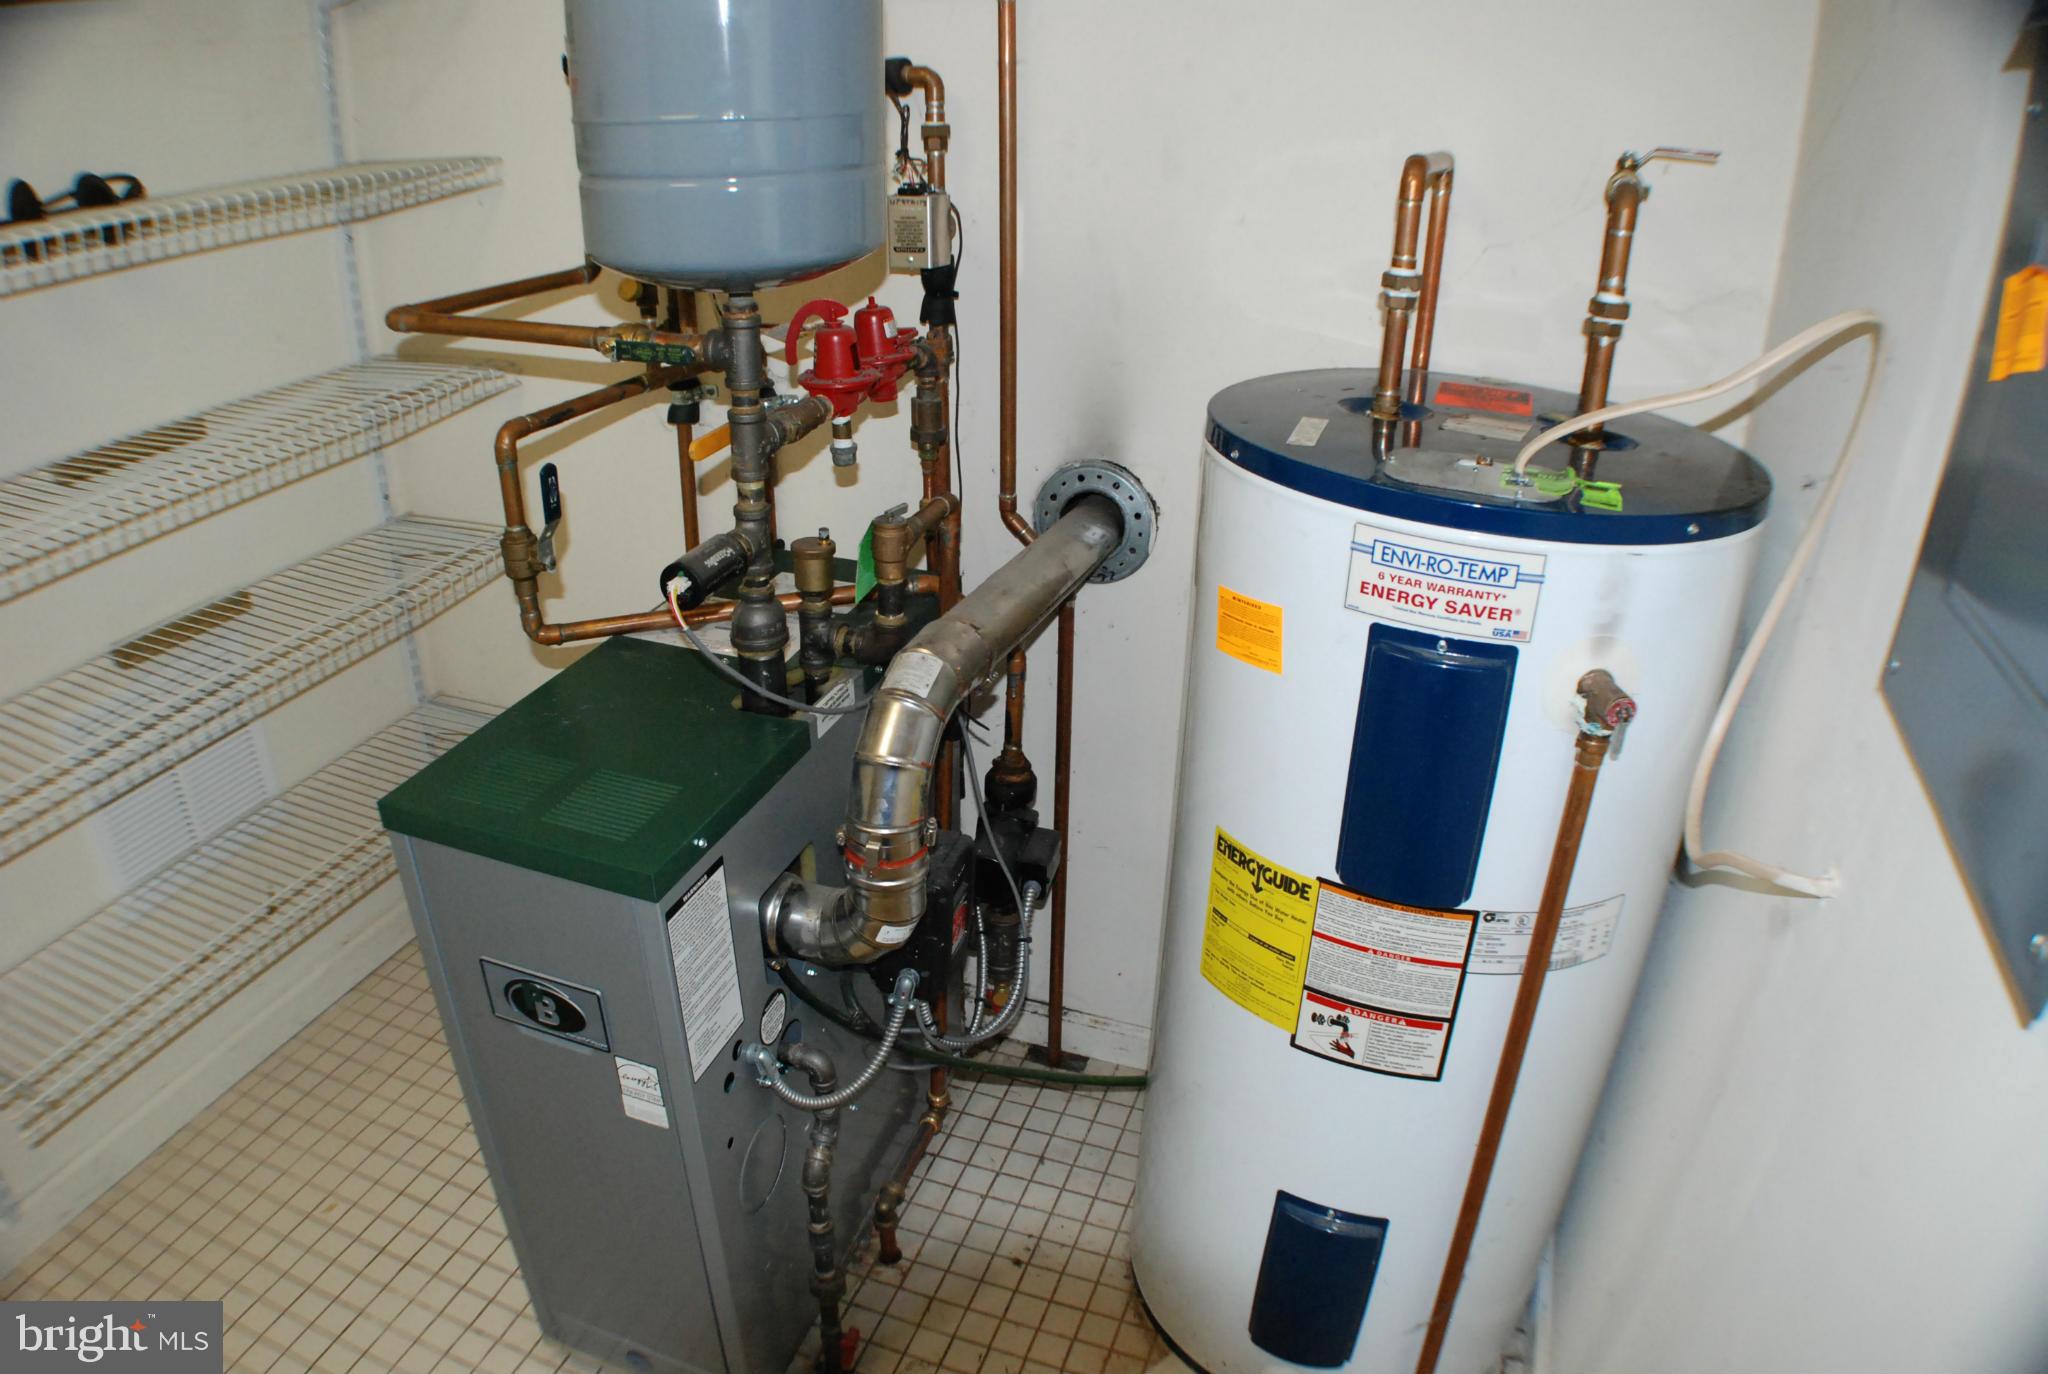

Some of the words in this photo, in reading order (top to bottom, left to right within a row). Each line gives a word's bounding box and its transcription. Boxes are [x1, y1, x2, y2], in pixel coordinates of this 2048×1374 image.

[1381, 545, 1509, 583] ENVI-RO-TEMP
[1359, 580, 1438, 610] ENERGY
[1378, 571, 1385, 580] 6
[1389, 573, 1423, 589] YEAR
[1217, 834, 1312, 901] ENERGYGUIDE
[535, 996, 561, 1027] B
[1353, 1008, 1398, 1024] DANGER
